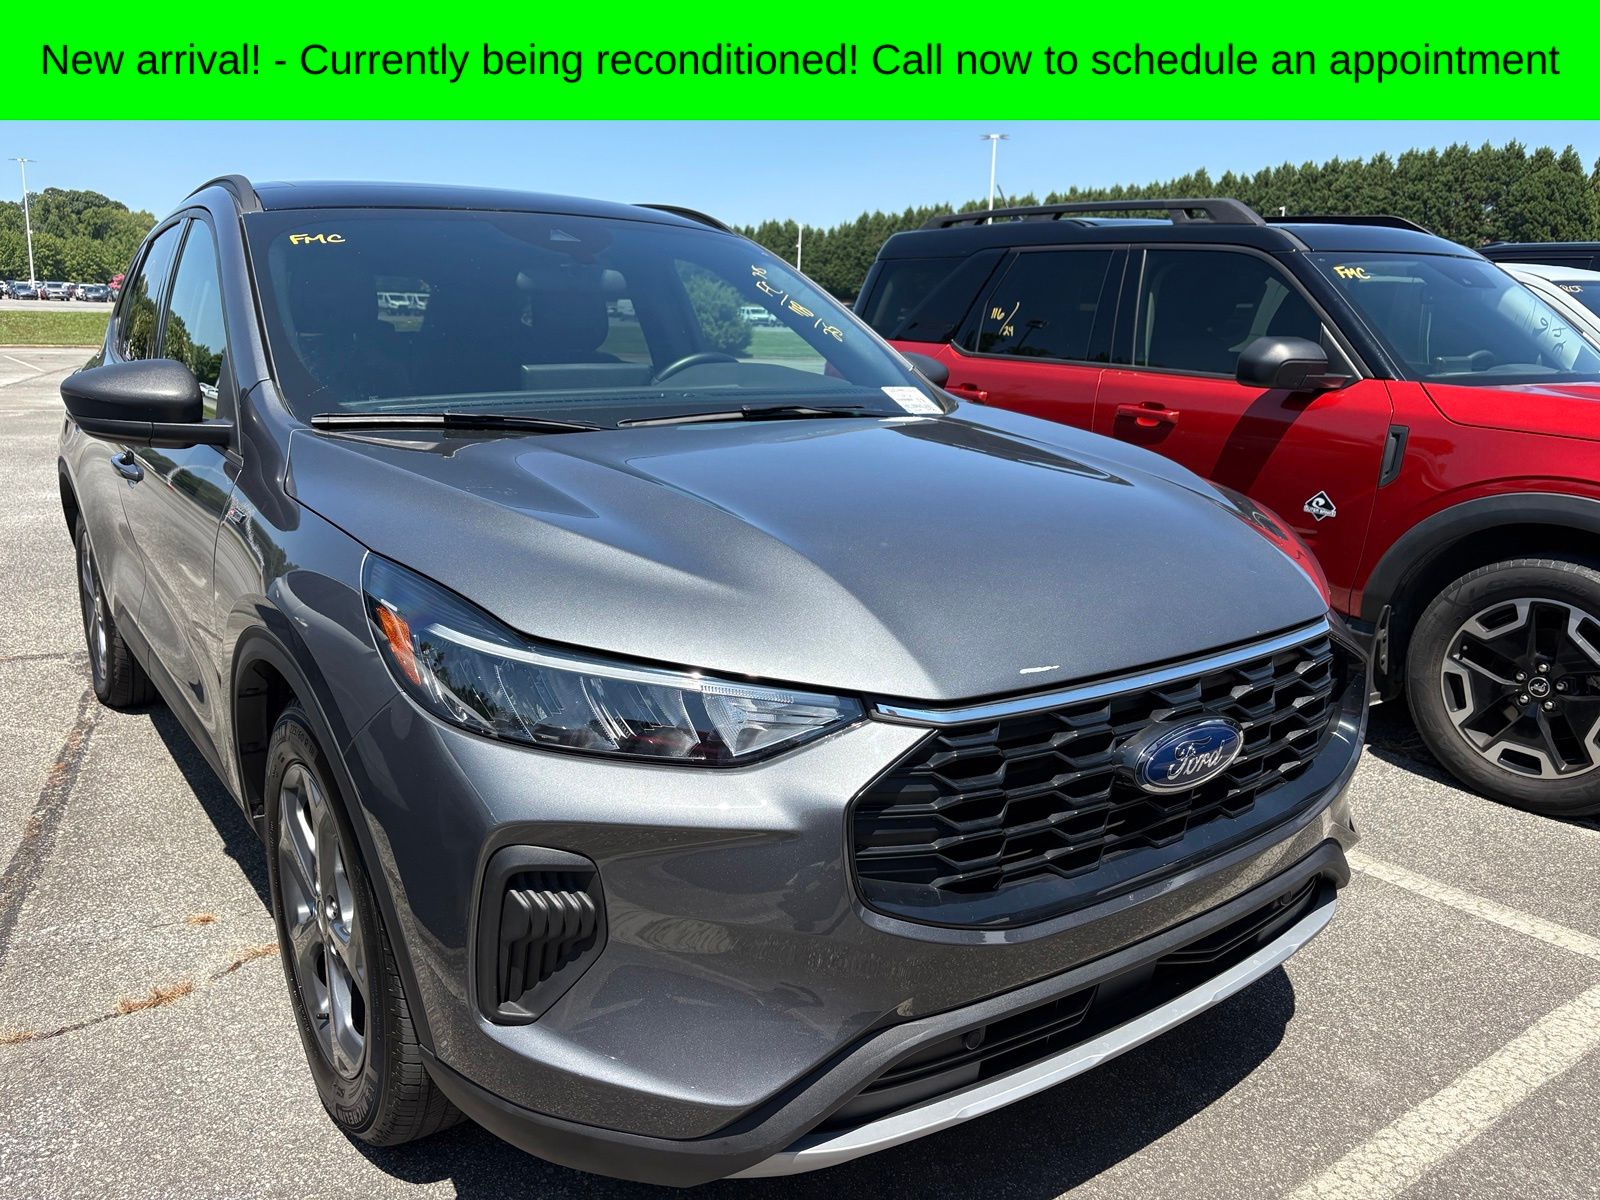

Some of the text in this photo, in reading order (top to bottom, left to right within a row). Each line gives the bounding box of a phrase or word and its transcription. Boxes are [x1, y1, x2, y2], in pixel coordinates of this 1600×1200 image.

[289, 233, 346, 245] FMC
[1333, 265, 1371, 279] FMC
[1166, 735, 1226, 781] Ford
